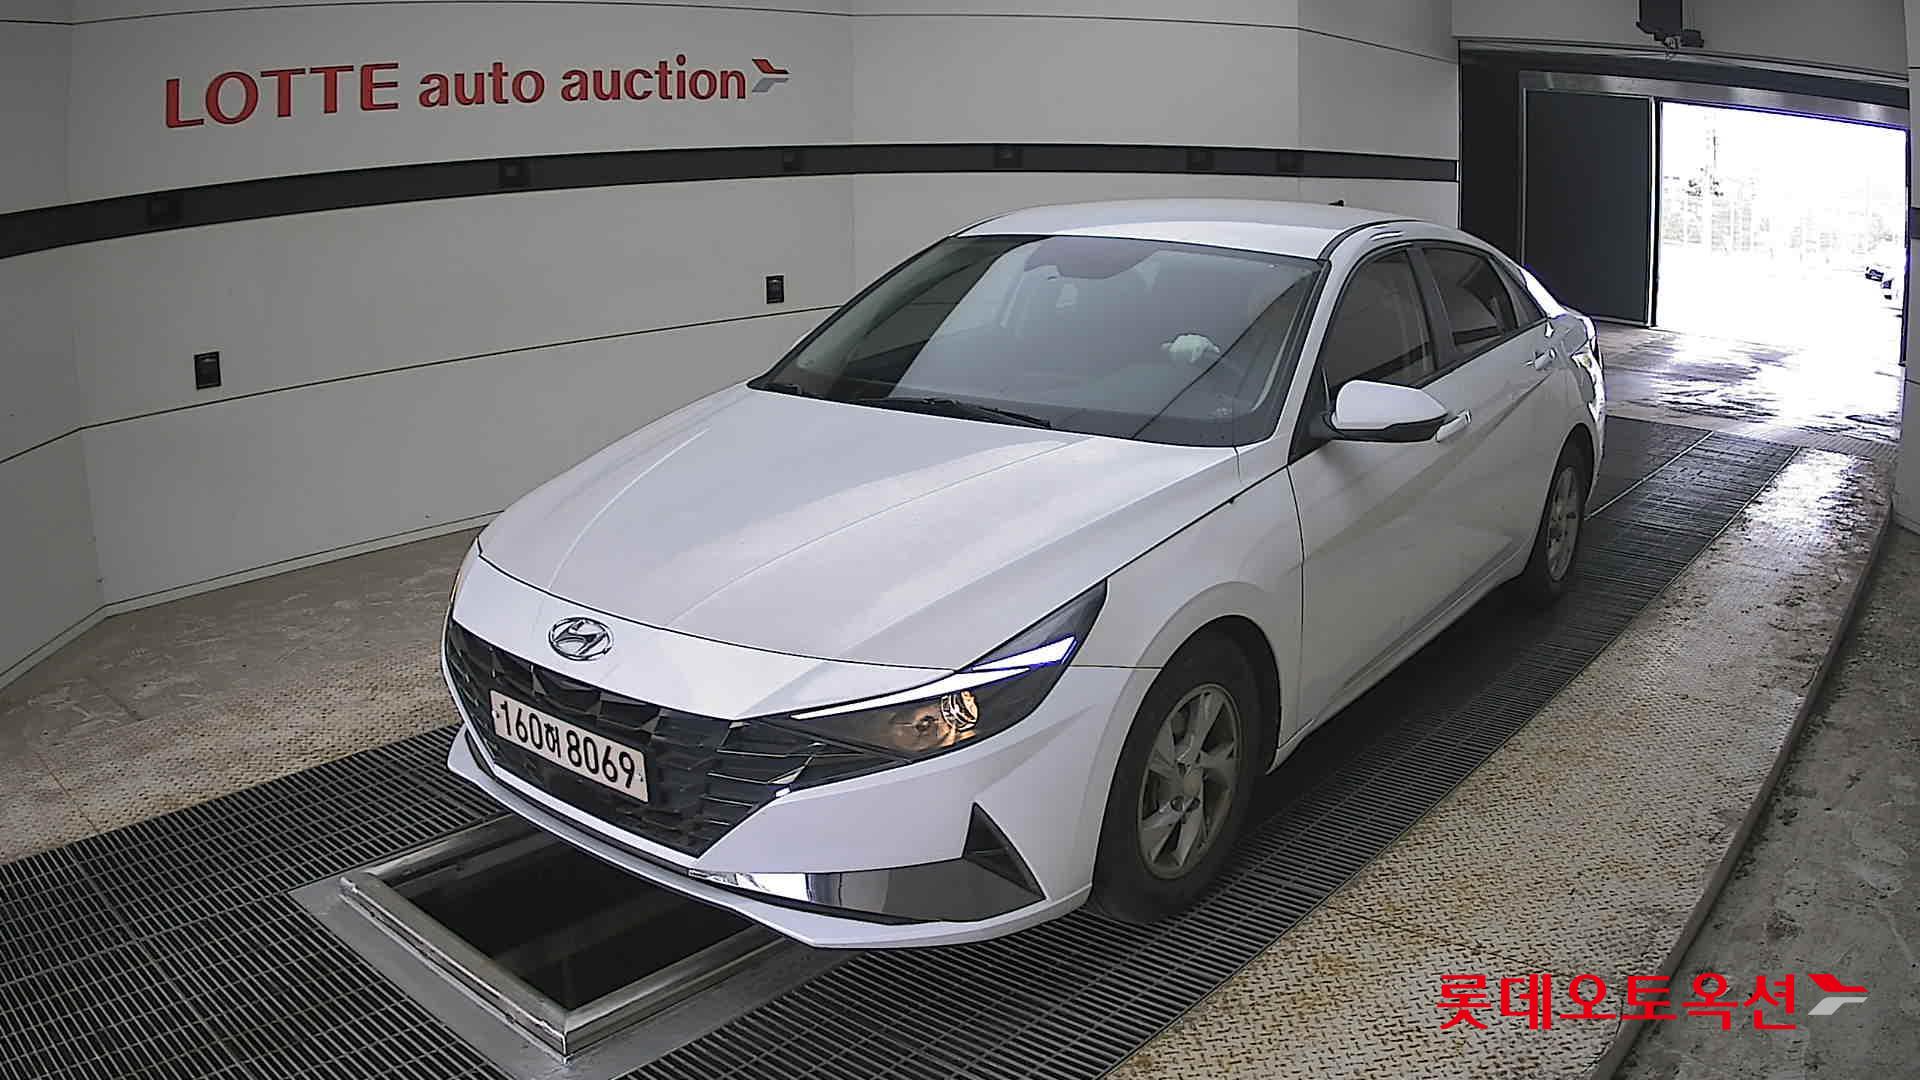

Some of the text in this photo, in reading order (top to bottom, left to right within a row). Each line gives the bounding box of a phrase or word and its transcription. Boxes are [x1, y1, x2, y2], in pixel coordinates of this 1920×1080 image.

[165, 53, 746, 128] LOTTE auto auction
